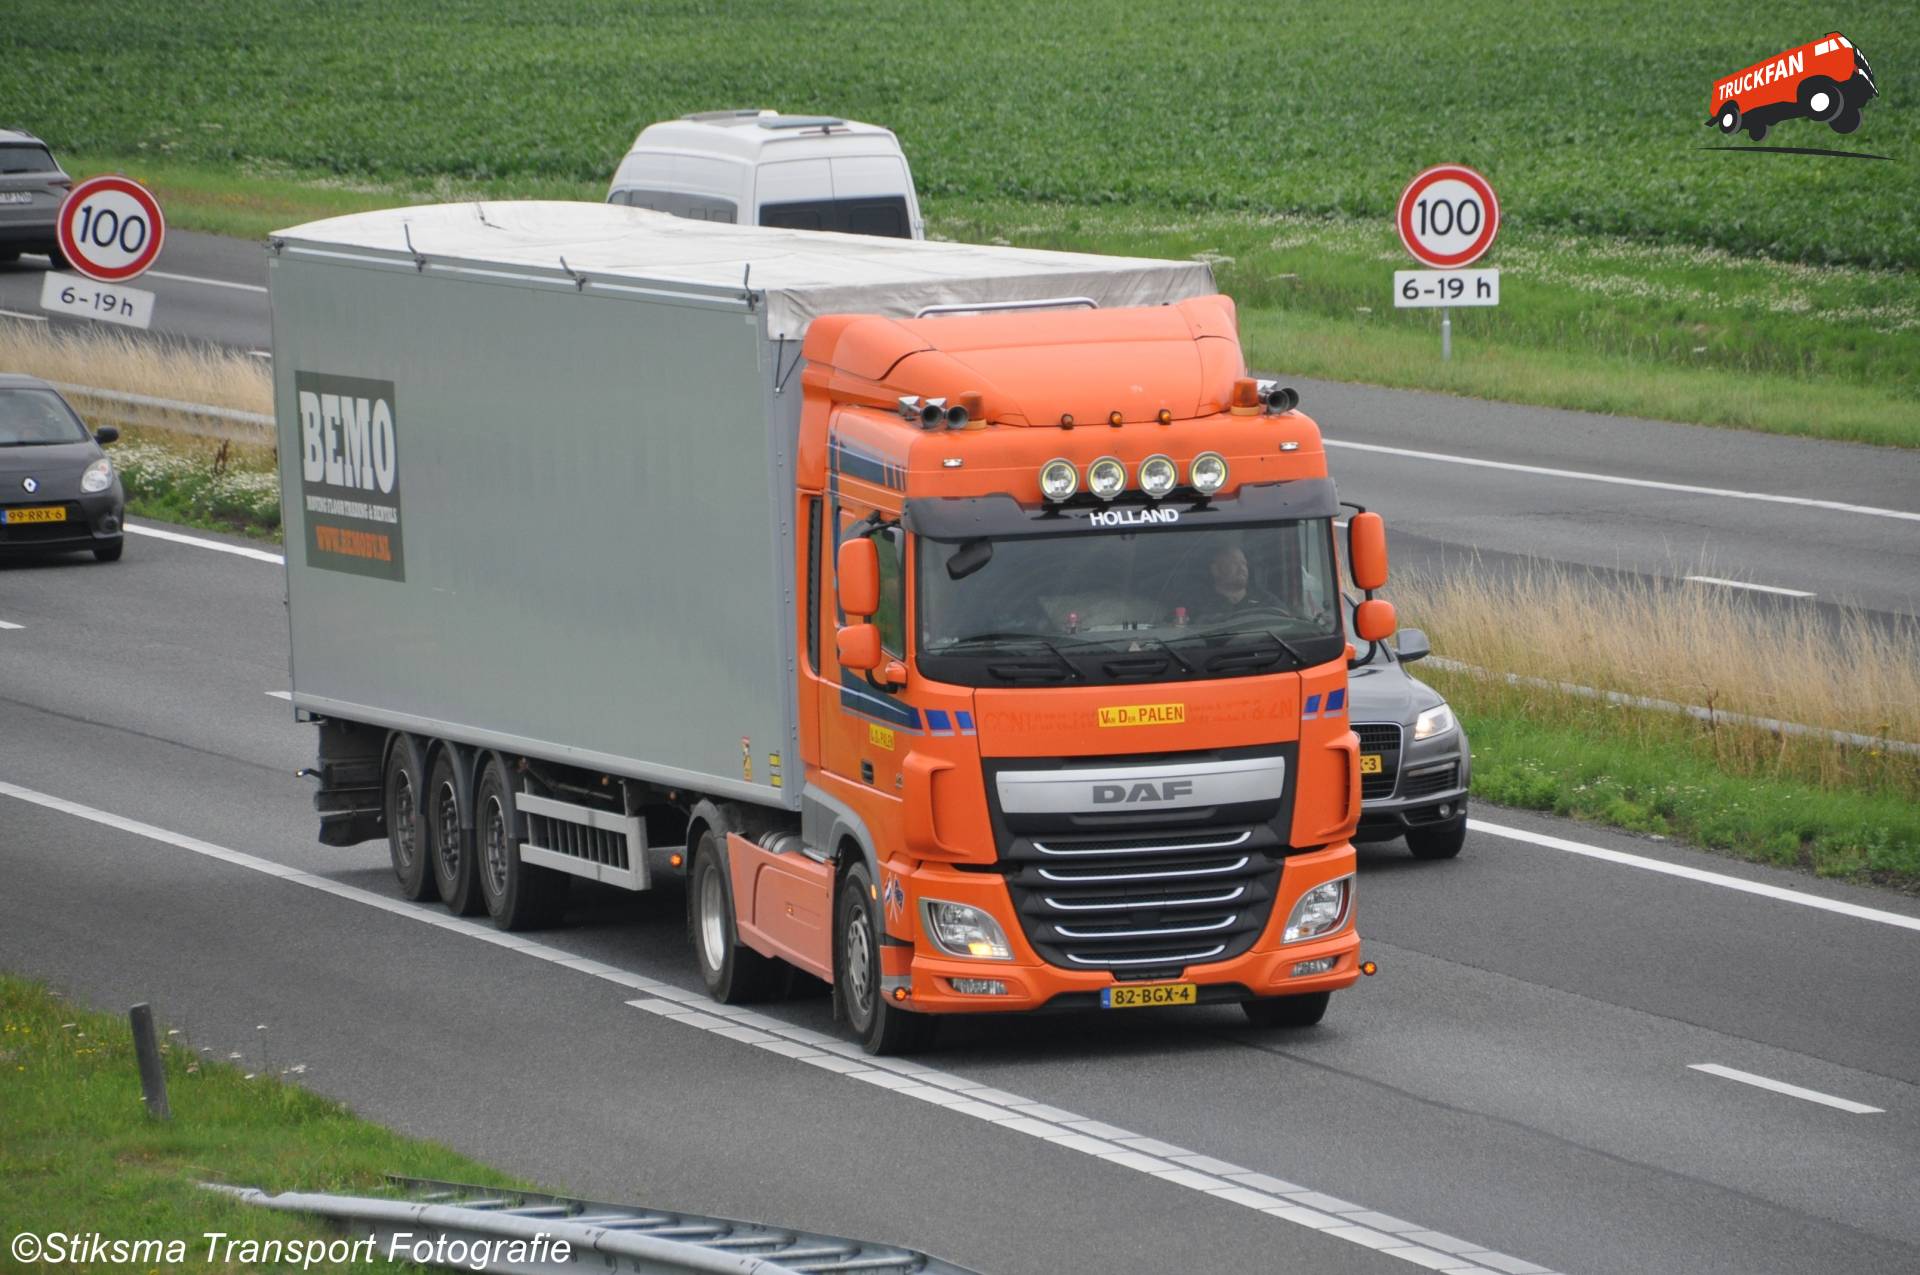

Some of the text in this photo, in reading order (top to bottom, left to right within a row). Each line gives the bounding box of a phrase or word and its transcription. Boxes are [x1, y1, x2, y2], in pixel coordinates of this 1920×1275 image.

[1417, 198, 1480, 236] 100
[80, 205, 146, 254] 100
[1402, 276, 1491, 300] 6-19 h
[61, 287, 133, 317] 6-19 h
[299, 390, 396, 494] BEMO
[1089, 508, 1179, 526] HOLLAND
[1139, 706, 1184, 722] PALEN
[1093, 780, 1193, 804] DAF
[1114, 986, 1190, 1005] 82-BGX-4
